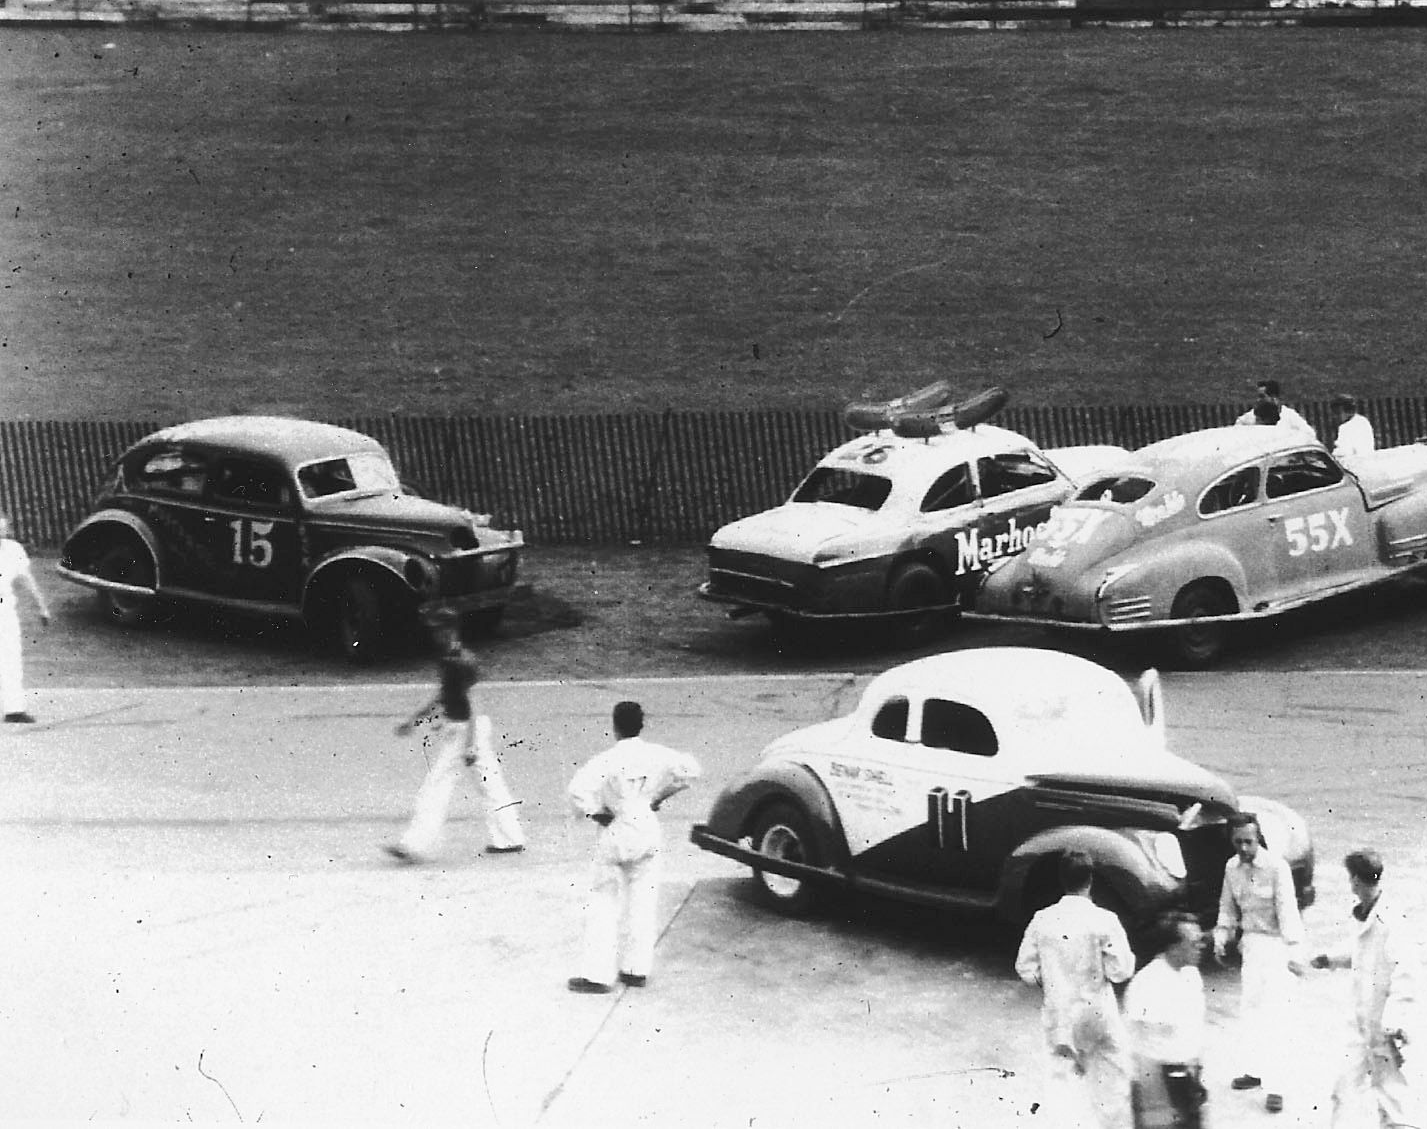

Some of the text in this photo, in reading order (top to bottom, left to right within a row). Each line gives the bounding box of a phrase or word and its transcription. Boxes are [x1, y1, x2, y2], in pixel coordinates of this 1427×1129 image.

[230, 520, 274, 567] 15
[954, 516, 1050, 576] Marhoe
[1283, 506, 1354, 557] 55X
